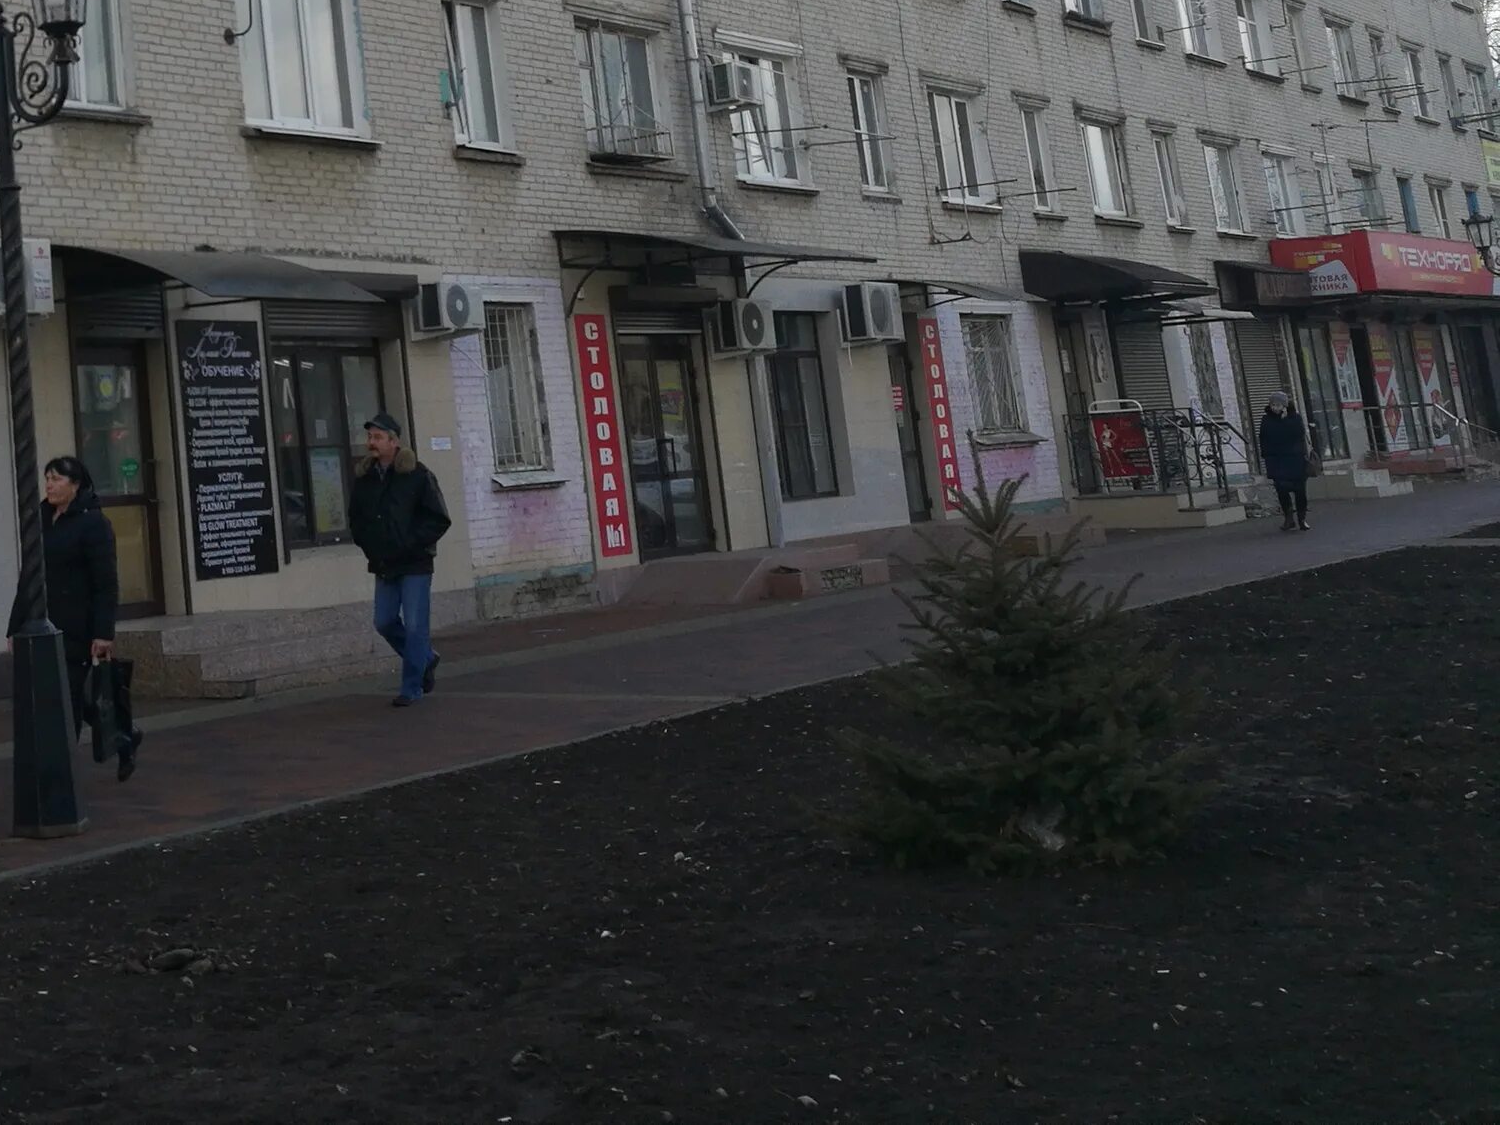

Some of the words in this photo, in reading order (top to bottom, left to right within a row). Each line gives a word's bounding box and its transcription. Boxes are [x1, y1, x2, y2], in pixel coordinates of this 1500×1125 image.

[1311, 283, 1349, 292] ХНИКА
[201, 366, 244, 377] ОБУЧЕНИЕ
[925, 325, 954, 479] СТОЛОВАЯ
[584, 322, 620, 517] СТОЛОВАЯ
[606, 523, 626, 548] №1
